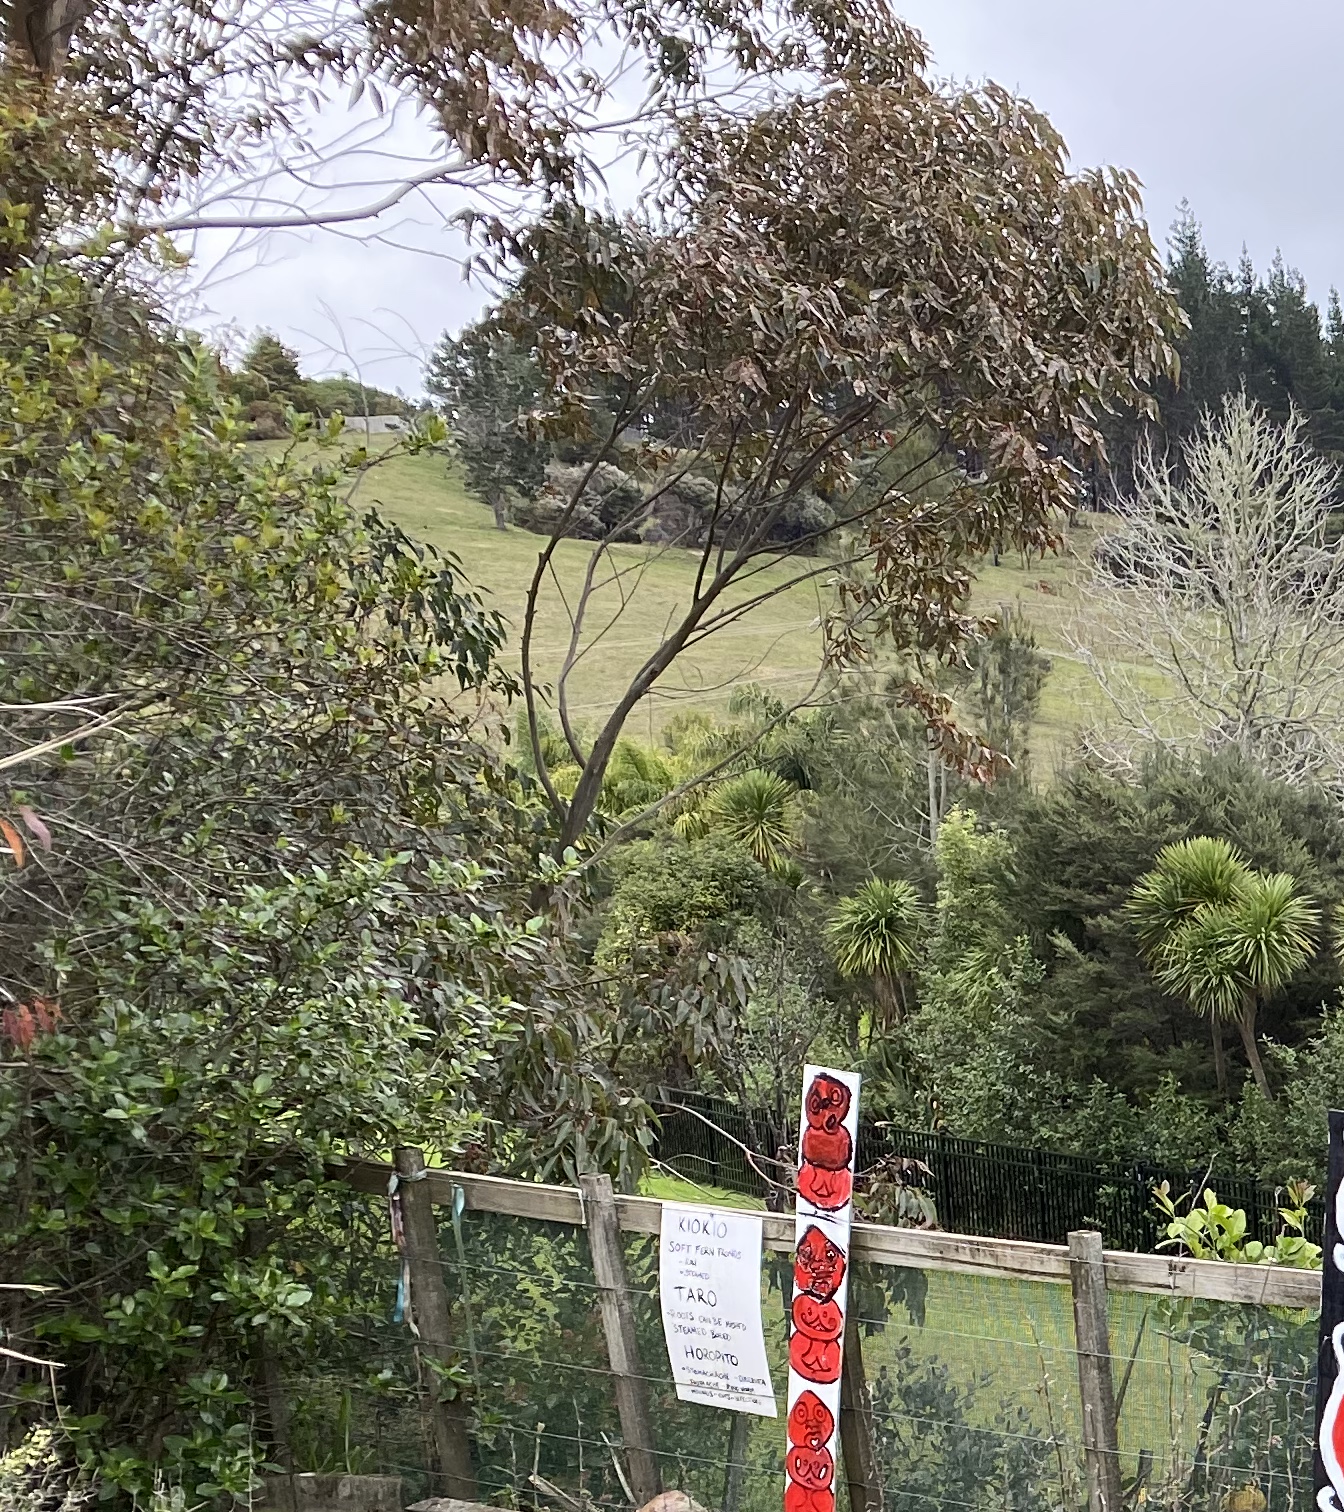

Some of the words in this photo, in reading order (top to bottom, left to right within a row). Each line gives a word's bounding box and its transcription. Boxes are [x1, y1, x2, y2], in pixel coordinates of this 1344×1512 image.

[679, 1216, 727, 1238] KIOKIO
[668, 1241, 692, 1253] SOFT
[695, 1245, 714, 1256] FERN
[674, 1286, 717, 1307] TARO
[684, 1345, 738, 1366] HOROPITO
